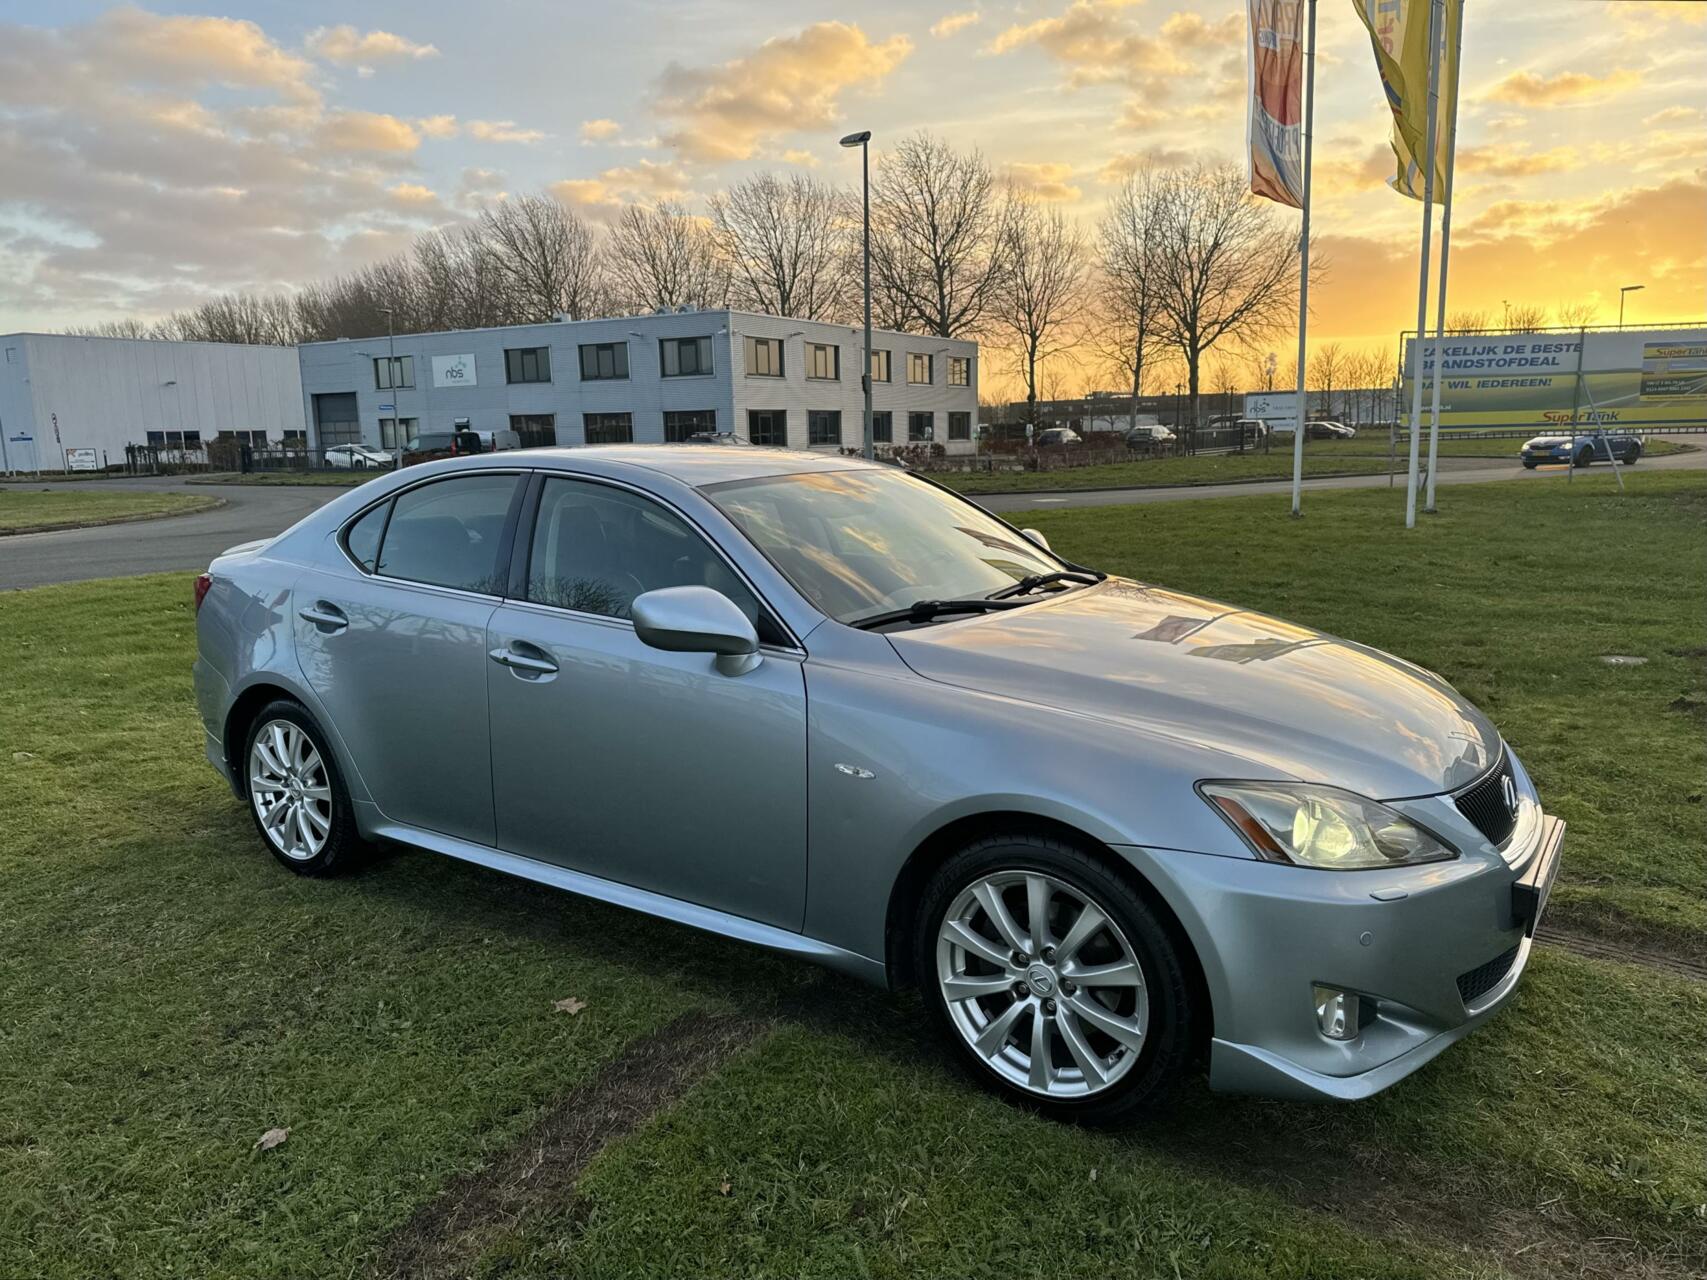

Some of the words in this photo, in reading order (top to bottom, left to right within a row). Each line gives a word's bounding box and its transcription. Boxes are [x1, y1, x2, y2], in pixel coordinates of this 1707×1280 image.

[1503, 345, 1526, 355] DE
[1530, 343, 1584, 353] BESTE
[445, 366, 464, 379] nbs
[1447, 380, 1472, 390] WIL
[1477, 378, 1552, 389] IEDEREEN!
